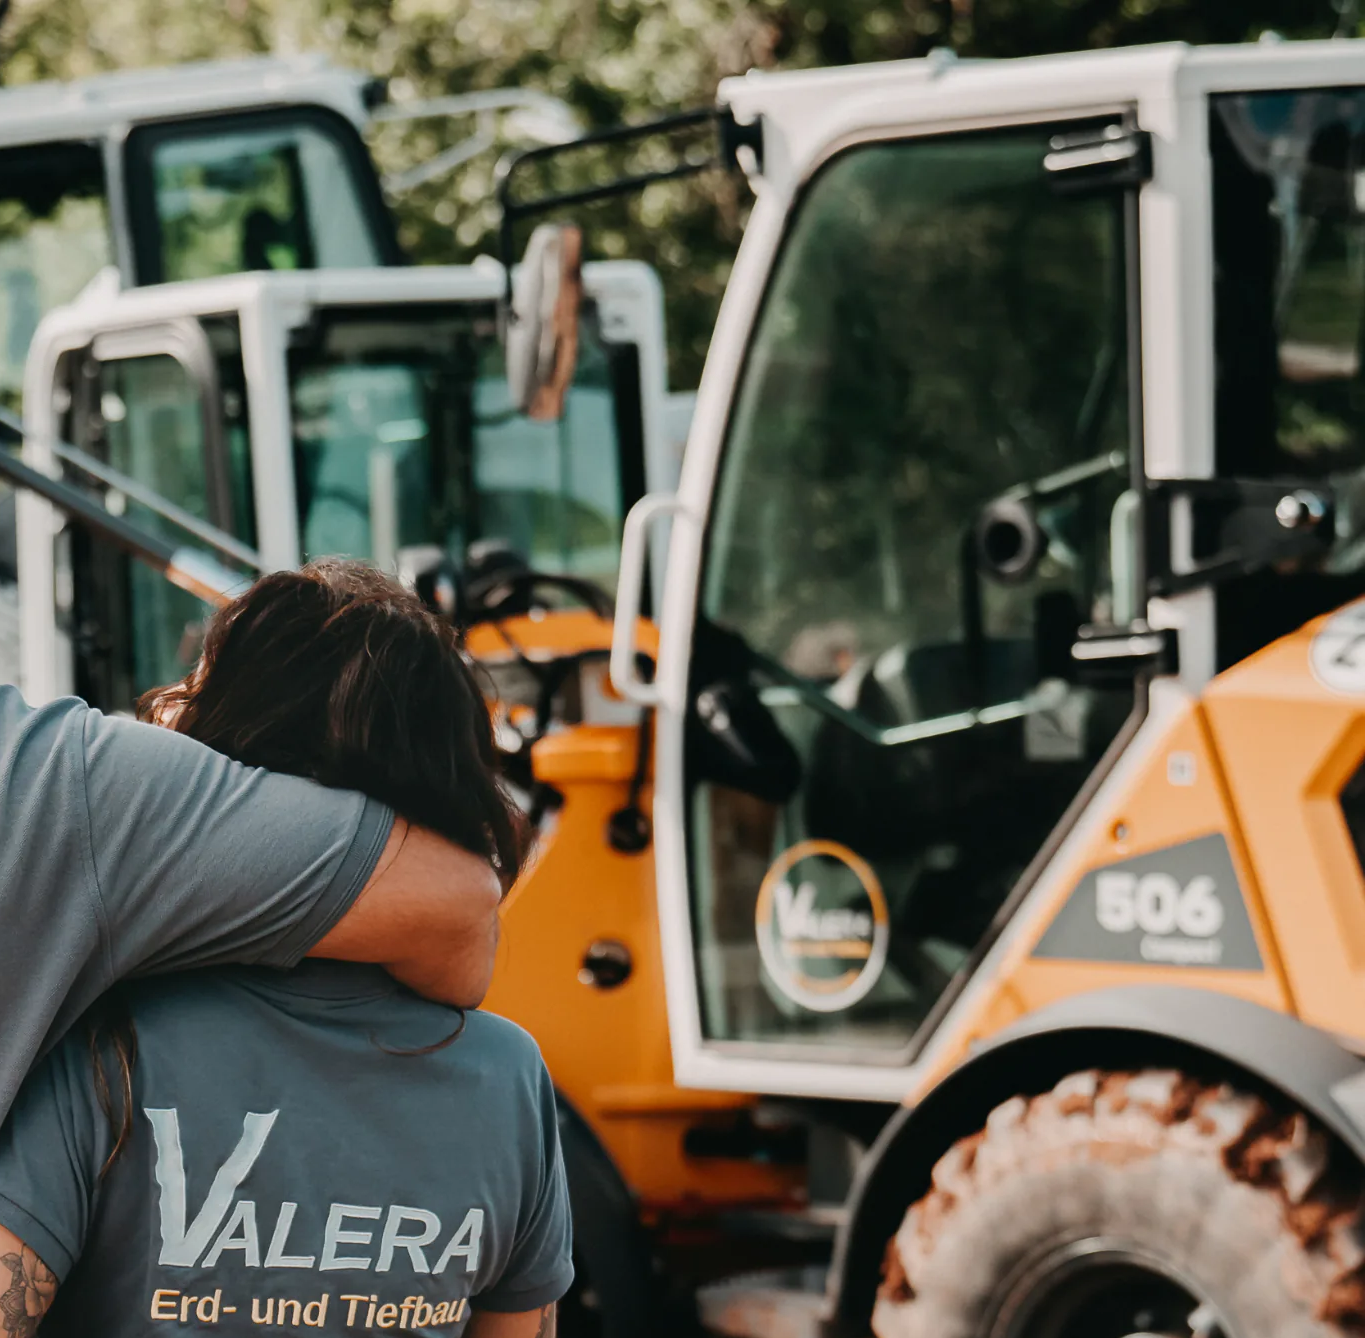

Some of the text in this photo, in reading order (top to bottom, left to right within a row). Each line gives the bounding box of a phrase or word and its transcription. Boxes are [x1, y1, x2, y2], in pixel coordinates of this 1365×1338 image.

[1096, 872, 1223, 937] 506
[143, 1108, 484, 1275] VALERA
[150, 1288, 467, 1329] Erd- und Tiefbau
